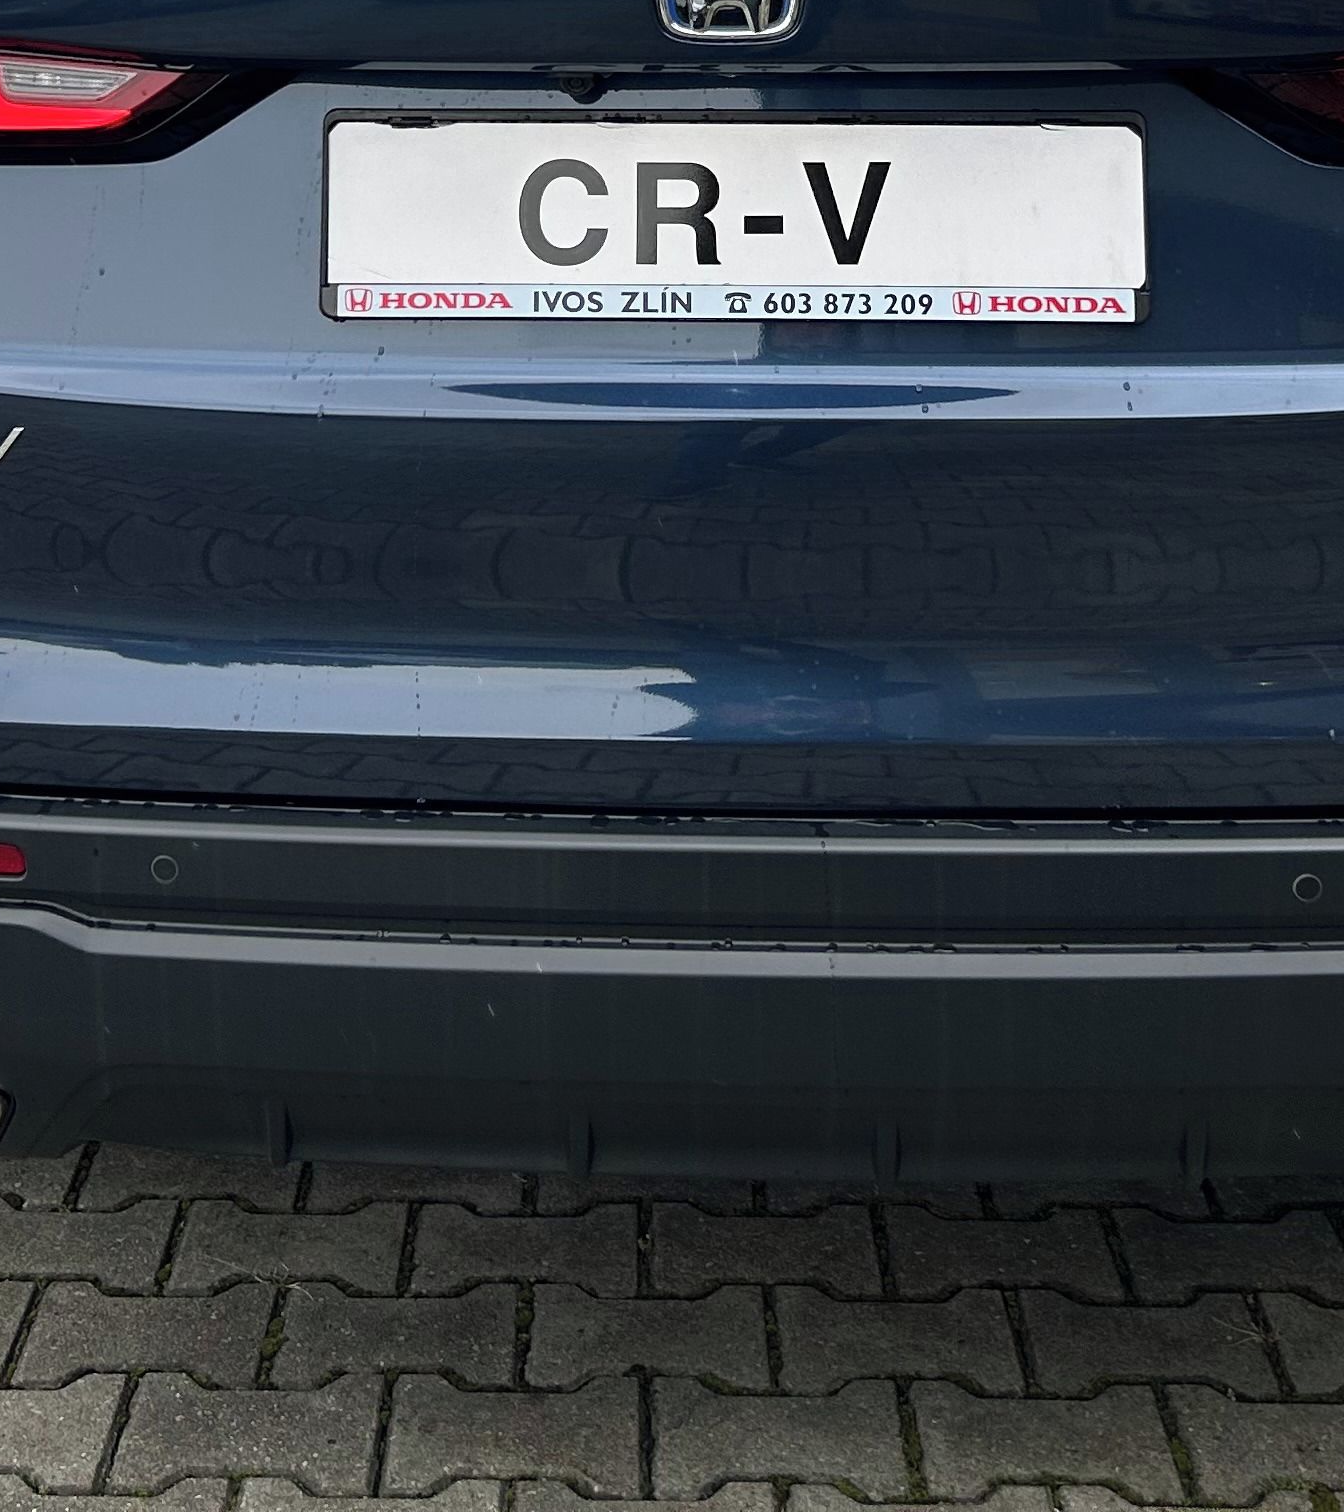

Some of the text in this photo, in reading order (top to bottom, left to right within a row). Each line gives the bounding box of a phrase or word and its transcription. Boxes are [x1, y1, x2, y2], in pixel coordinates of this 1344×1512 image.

[518, 158, 892, 267] CR-V
[379, 286, 1127, 316] HONDA IVOS ZLÍN 603 873 209 HONDA
